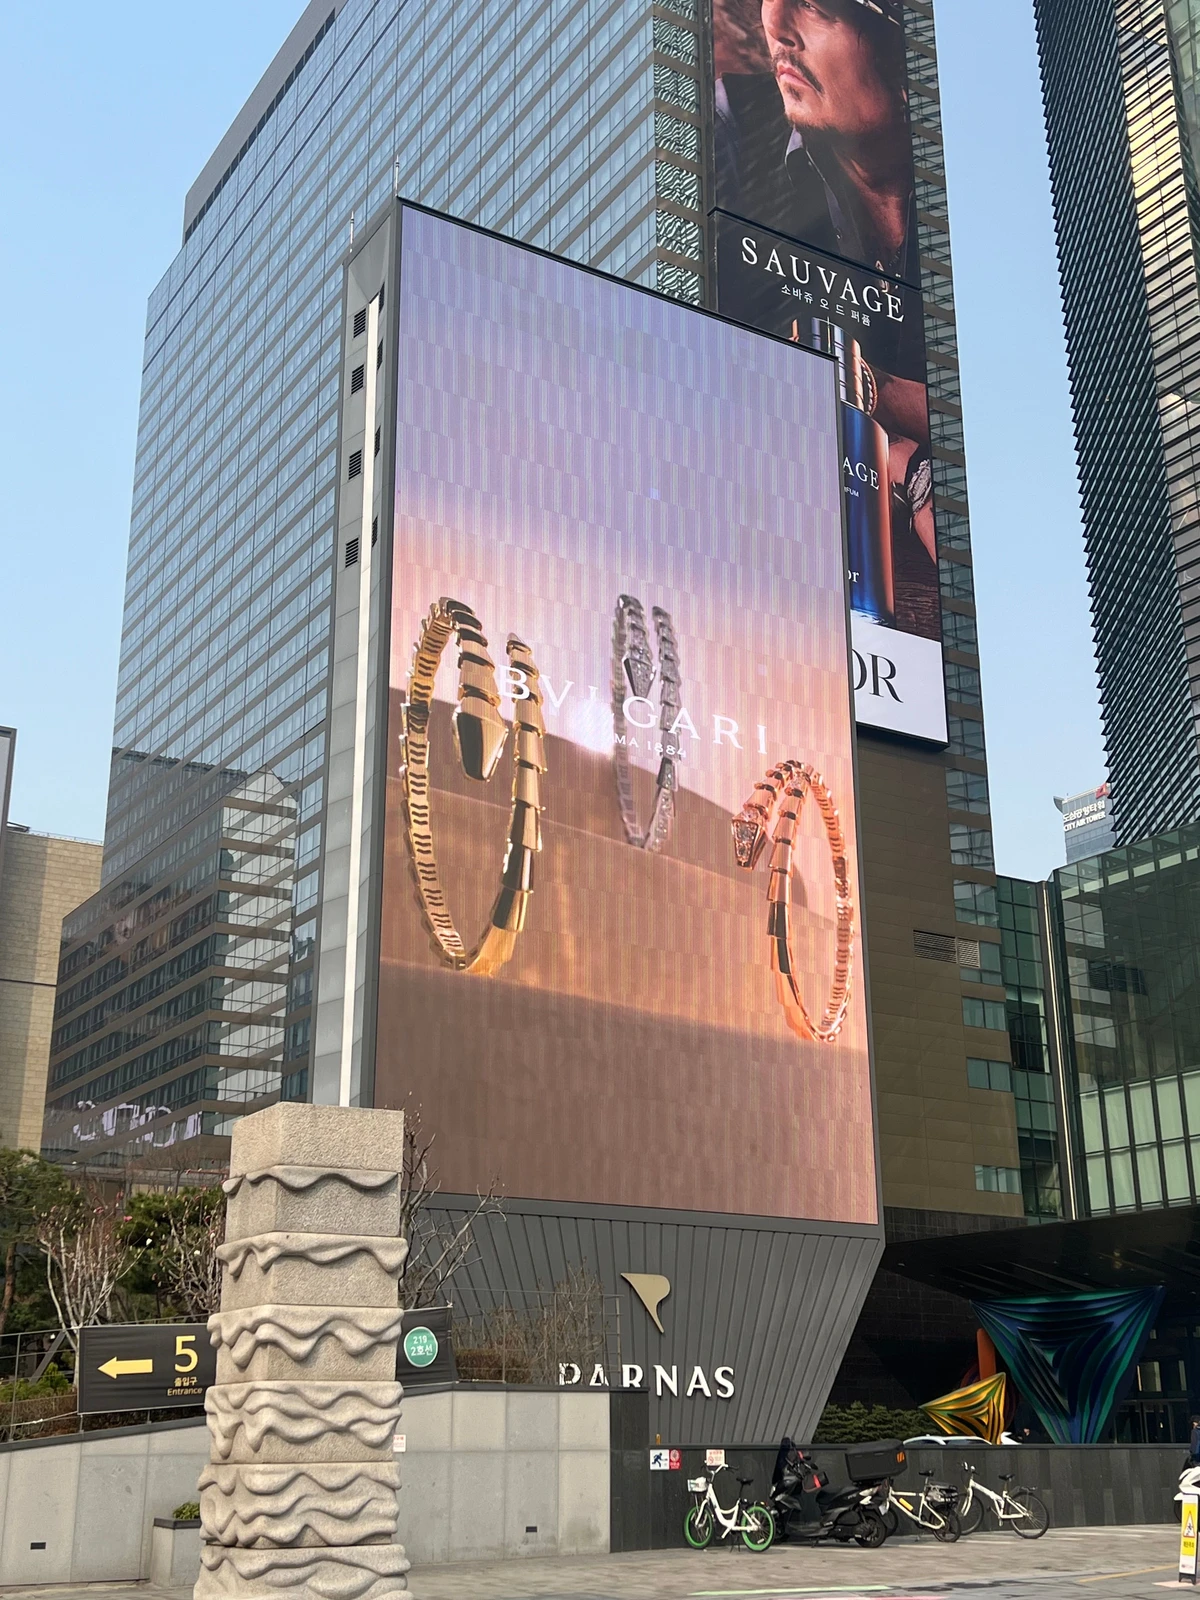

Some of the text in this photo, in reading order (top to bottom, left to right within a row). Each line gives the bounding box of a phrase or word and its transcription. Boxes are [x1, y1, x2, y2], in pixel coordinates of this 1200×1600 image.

[741, 236, 905, 323] SAUVAGE
[781, 284, 814, 305] 소바쥬
[819, 298, 830, 310] 오
[835, 304, 845, 316] 드
[647, 740, 687, 758] 1884
[1063, 811, 1106, 832] CITY AIR TOWER
[412, 1335, 428, 1345] 219
[174, 1335, 199, 1373] 5
[410, 1344, 434, 1357] 2호선
[174, 1376, 198, 1387] 출입구
[558, 1362, 735, 1398] PARNAS
[167, 1387, 203, 1397] Entrance
